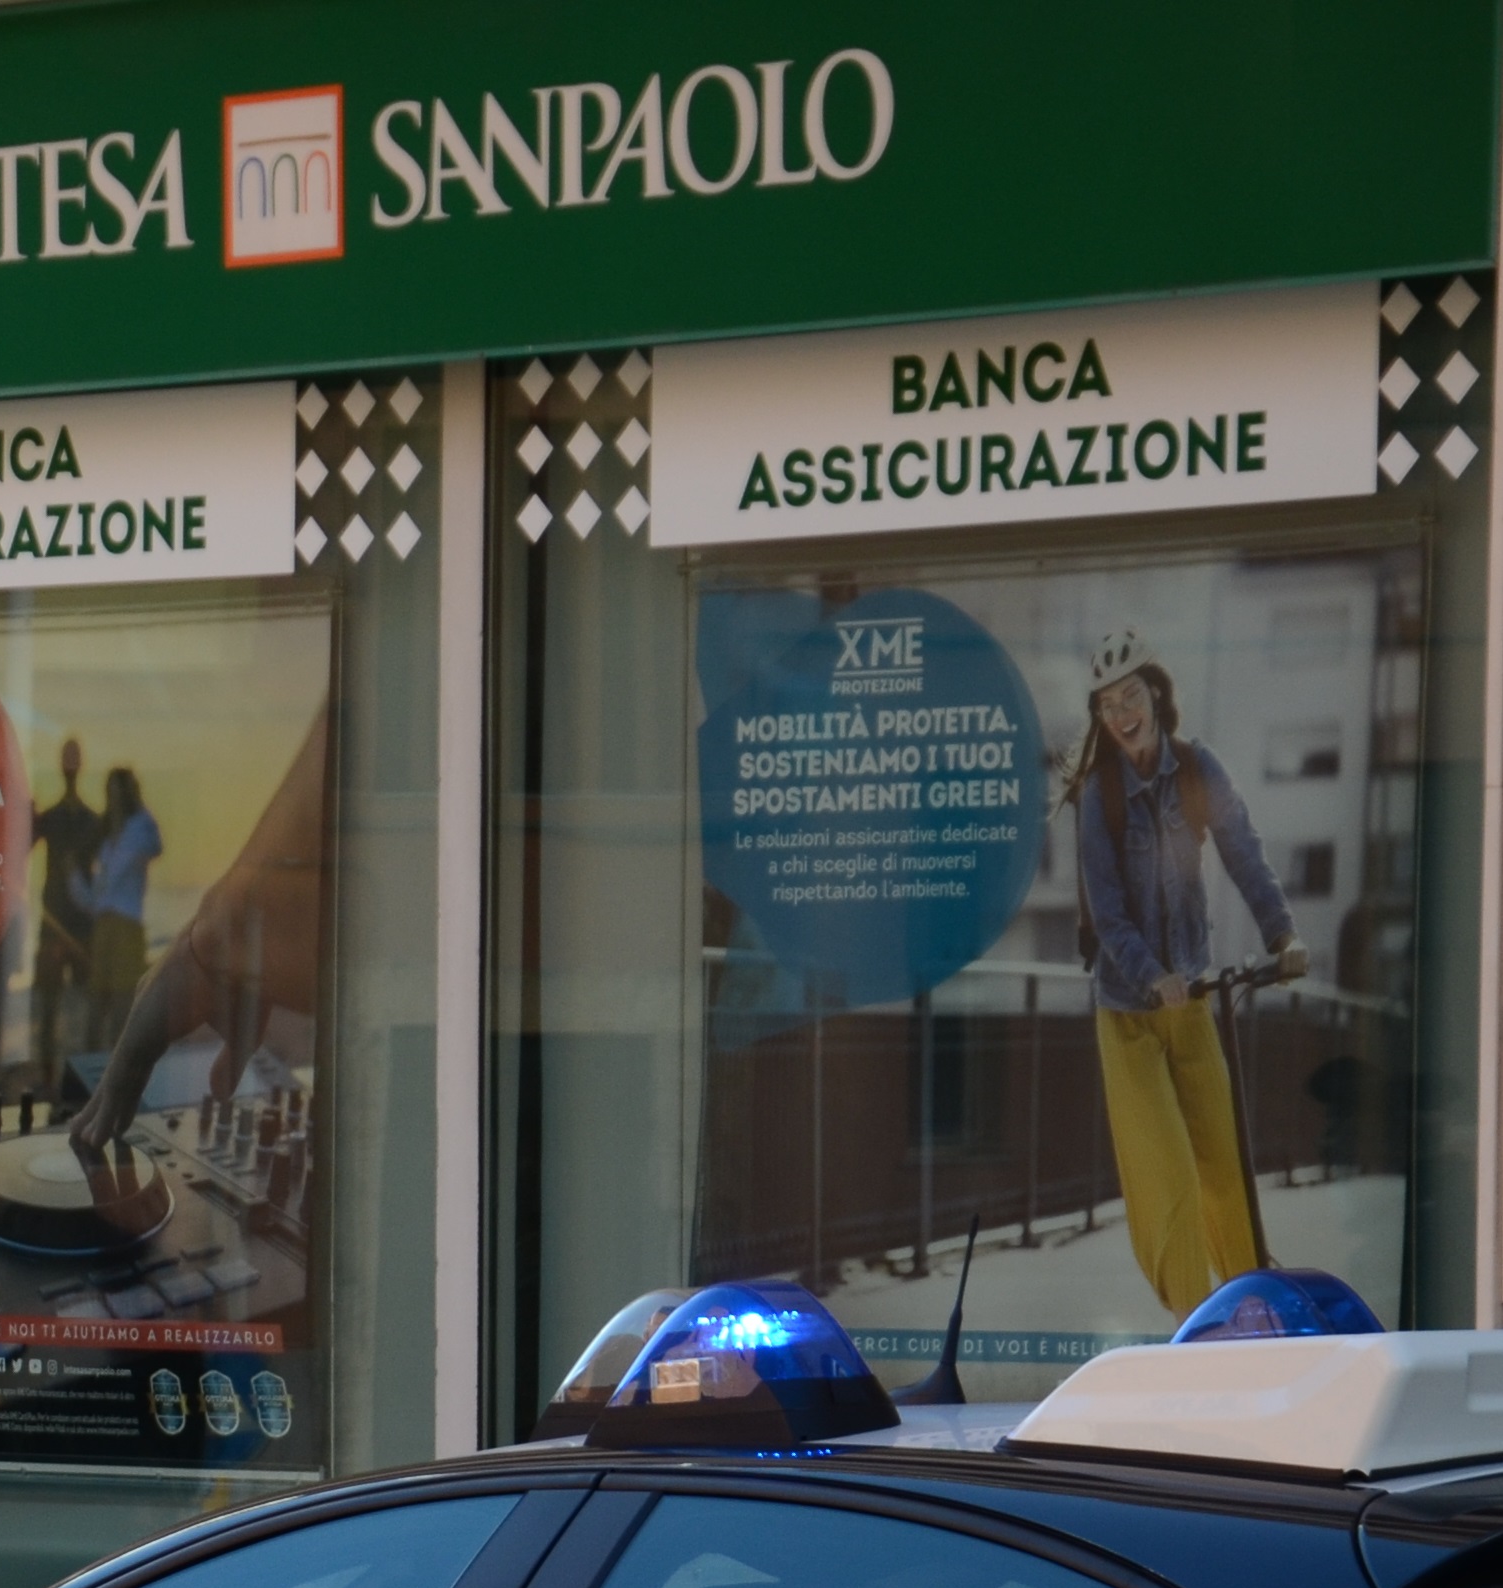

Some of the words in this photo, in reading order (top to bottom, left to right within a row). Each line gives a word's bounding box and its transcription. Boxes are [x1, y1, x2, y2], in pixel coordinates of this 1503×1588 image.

[370, 47, 895, 229] SANPAOLO
[892, 338, 1112, 415] BANCA
[738, 411, 1267, 511] ASSICURAZIONE
[832, 677, 923, 694] PROTEZIONE
[737, 704, 868, 741] MOBILITÀ
[878, 705, 1017, 737] PROTETTA.
[740, 748, 921, 777] SOSTENIAMO
[928, 747, 939, 773] I
[945, 743, 1013, 772] TUOI
[734, 783, 922, 815] SPOSTAMENTI
[929, 779, 1019, 807] GREEN
[736, 830, 752, 849] Le
[756, 827, 830, 848] soluzioni
[835, 825, 937, 846] assicurative
[941, 822, 1017, 843] dedicate
[769, 860, 776, 873] a
[782, 857, 807, 874] chi
[813, 855, 878, 876] sceglie
[883, 852, 897, 872] di
[902, 851, 976, 872] muoversi
[772, 881, 876, 903] rispettando
[882, 877, 970, 899] l'ambiente.
[9, 1323, 37, 1337] NOI
[43, 1324, 56, 1337] TI
[63, 1326, 139, 1341] AIUTIAMO
[148, 1328, 157, 1342] A
[164, 1329, 275, 1345] REALIZZARLO
[908, 1338, 942, 1353] CUR
[964, 1339, 984, 1354] DI
[996, 1340, 1029, 1354] VOI
